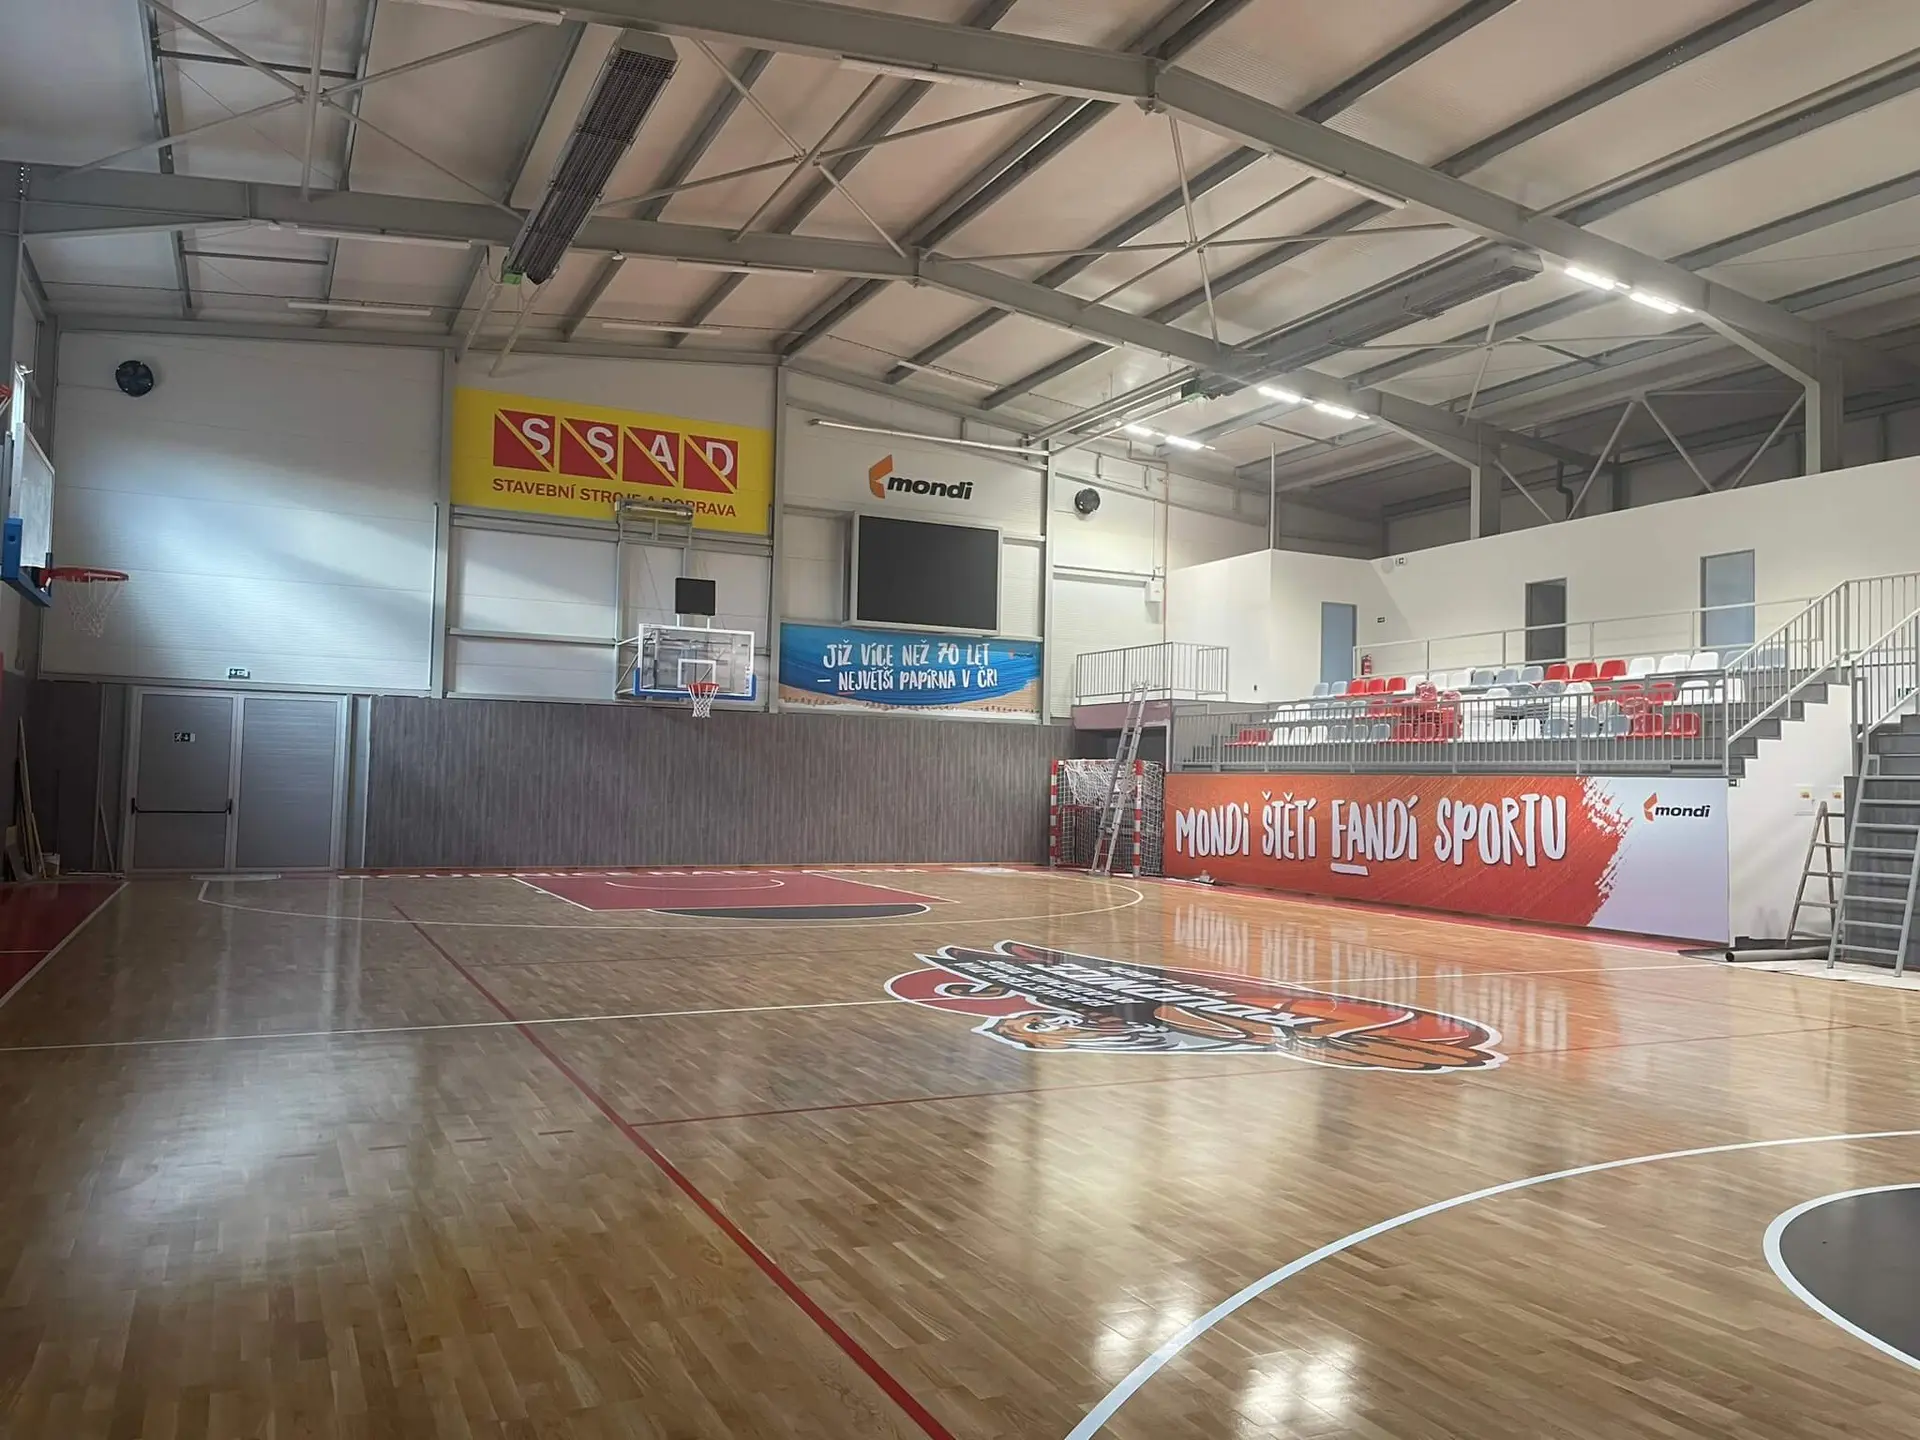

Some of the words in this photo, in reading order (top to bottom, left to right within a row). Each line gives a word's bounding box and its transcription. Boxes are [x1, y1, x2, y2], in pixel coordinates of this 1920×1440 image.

[492, 478, 576, 500] STAVEBNÍ
[887, 476, 974, 500] mondi
[861, 642, 893, 666] VÍCE
[902, 640, 930, 666] NEŽ
[938, 642, 959, 665] 70
[966, 643, 990, 665] LET
[962, 671, 970, 688] V
[1655, 805, 1711, 818] mondi
[1176, 801, 1250, 858] MONDI
[1262, 790, 1317, 860] ŠTĚTÍ
[1331, 795, 1418, 862] FANDÍ
[1434, 793, 1567, 867] SPORTU
[1028, 963, 1326, 1027] ROUDNICE
